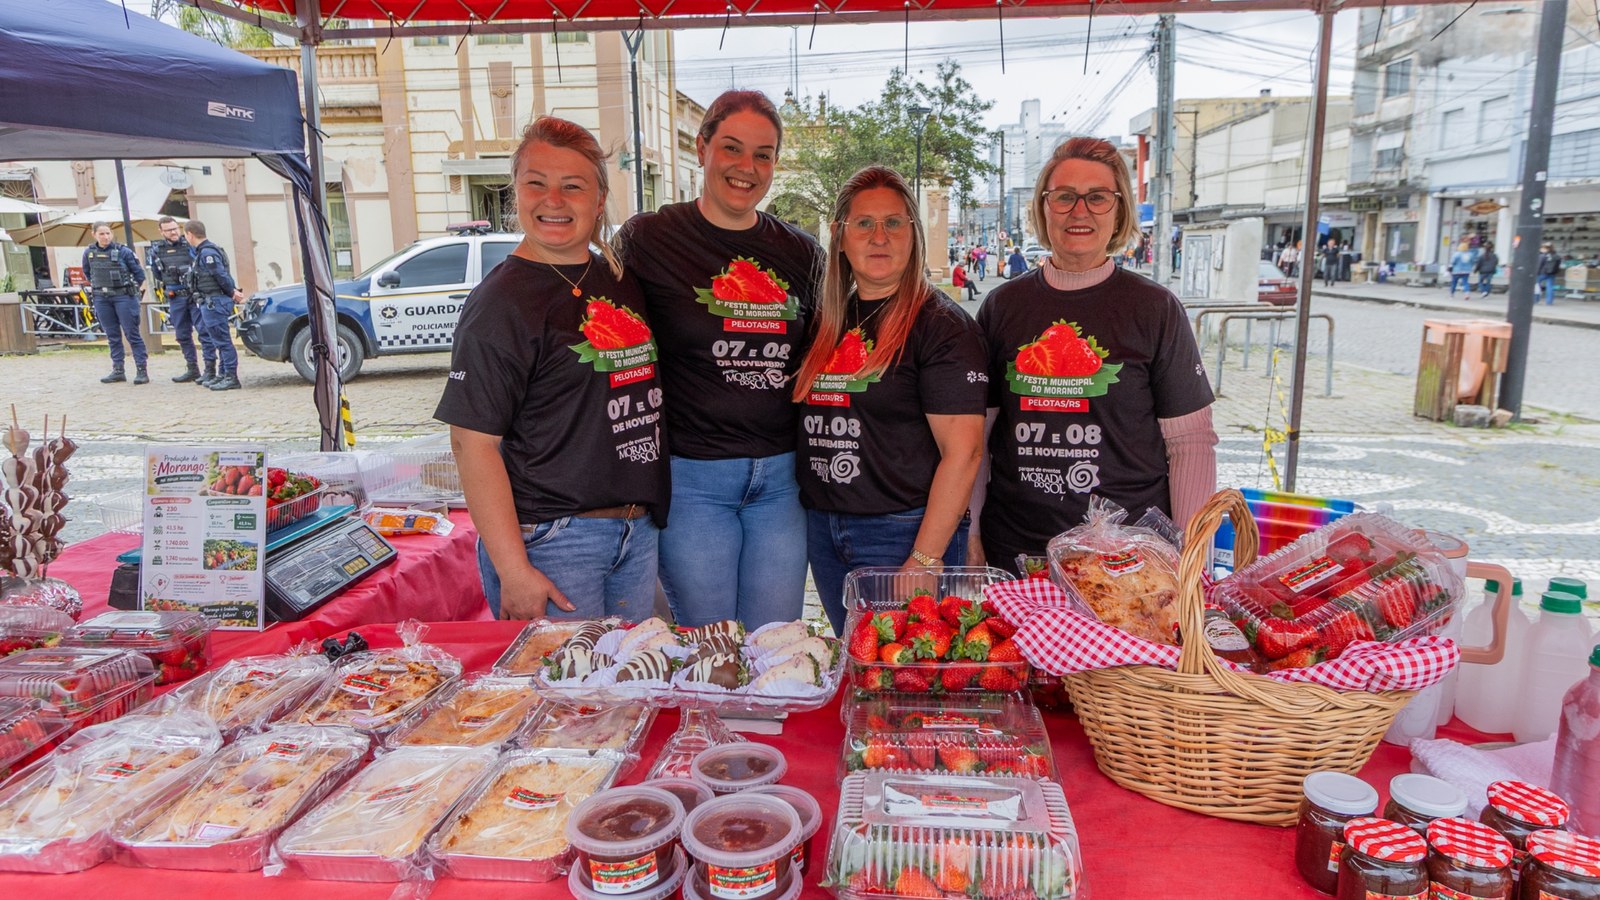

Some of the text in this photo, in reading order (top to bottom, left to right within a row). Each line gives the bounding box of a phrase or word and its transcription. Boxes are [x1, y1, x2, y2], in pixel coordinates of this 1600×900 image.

[226, 106, 254, 120] NTK
[724, 301, 748, 310] FESTA
[750, 303, 788, 311] MUNICIPAL
[733, 309, 782, 318] DO MORANGO
[731, 320, 780, 330] PELOTAS/RS
[606, 350, 625, 359] FESTA
[712, 339, 791, 360] 07 E 08
[614, 359, 622, 368] DO
[716, 359, 786, 369] DE NOVEMBRO
[614, 367, 652, 382] PELOTAS/RS
[1023, 375, 1048, 385] FESTA
[1049, 378, 1094, 387] MUNICIPAL
[1031, 385, 1084, 395] DO MORANGO
[607, 387, 663, 420] 07 E 08
[811, 393, 845, 402] PELOTAS/RS
[1028, 399, 1081, 408] PELOTAS/RS
[612, 421, 626, 434] DE
[804, 415, 824, 434] 07
[830, 416, 861, 438] 08
[1014, 422, 1102, 445] 07 E 08
[808, 438, 817, 447] DE
[618, 441, 657, 460] MORADA
[630, 449, 659, 464] DO SOL
[1017, 446, 1099, 458] DE NOVEMBRO
[157, 461, 205, 476] Morango
[1020, 472, 1065, 484] MORADA
[1044, 482, 1066, 495] SOL
